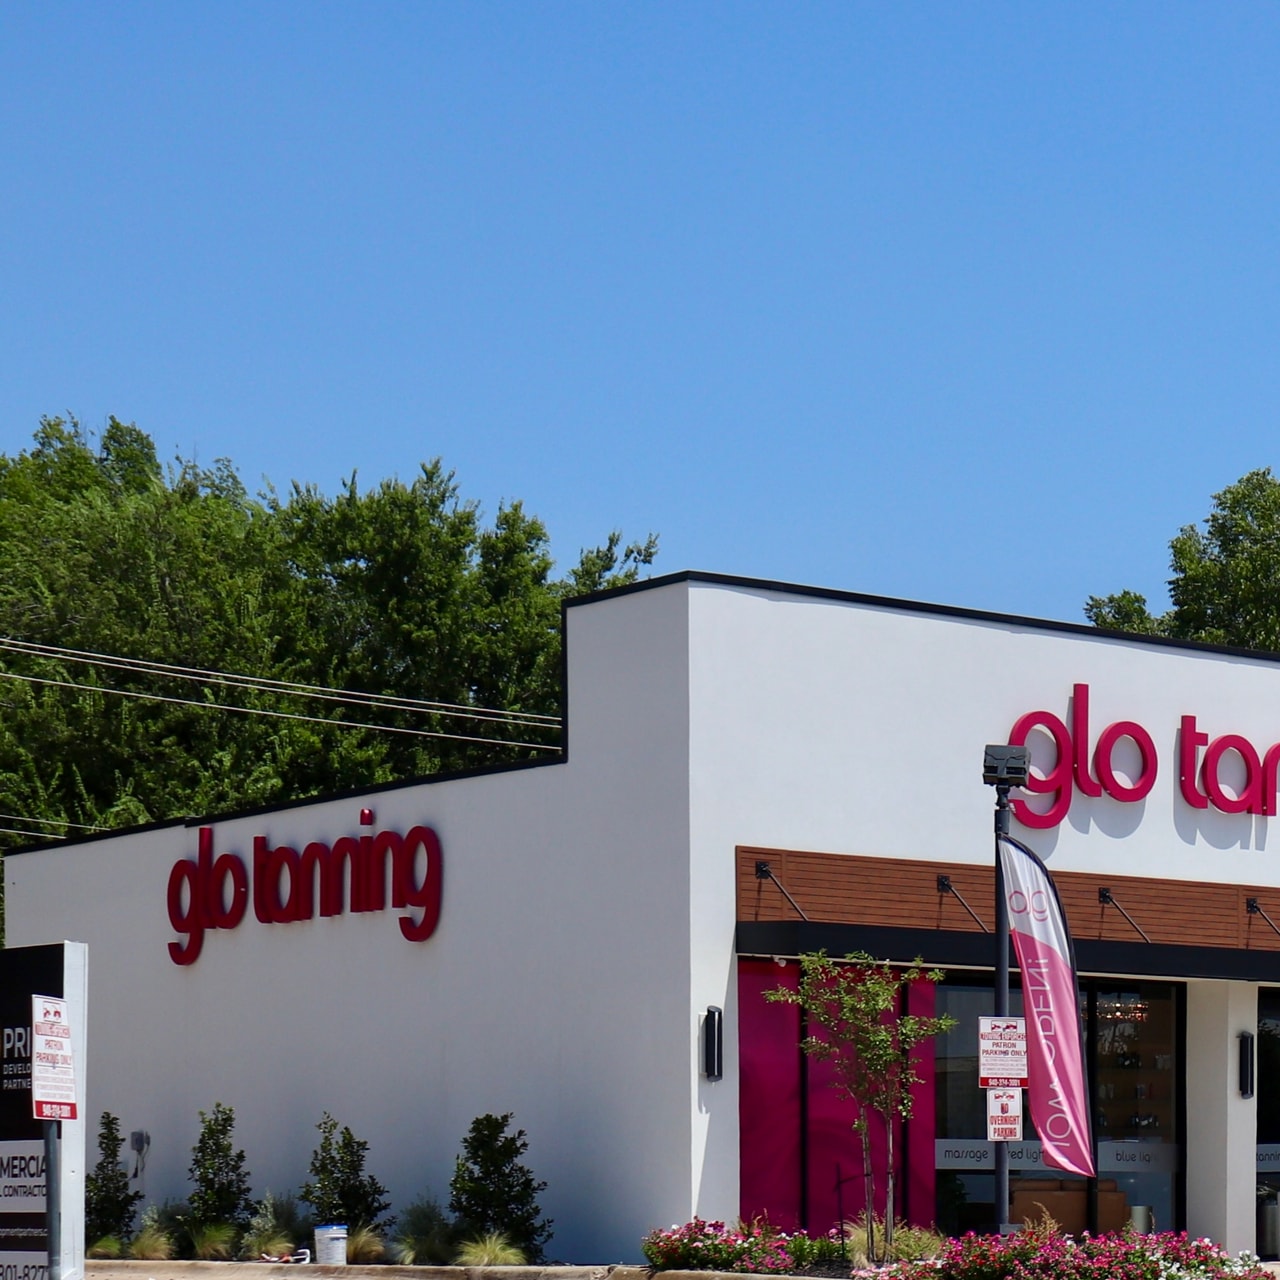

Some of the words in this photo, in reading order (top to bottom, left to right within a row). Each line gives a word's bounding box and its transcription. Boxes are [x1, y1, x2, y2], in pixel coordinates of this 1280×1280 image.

[1009, 683, 1158, 829] glo
[167, 827, 248, 966] glo
[253, 809, 443, 942] tanning
[991, 1041, 1017, 1049] PATRON
[982, 1049, 1009, 1057] PARKING
[1010, 1049, 1027, 1057] ONLY
[1000, 1102, 1010, 1115] NO
[990, 1115, 1020, 1126] OVERNIGHT
[993, 1127, 1017, 1138] PARKING
[944, 1149, 989, 1163] massage
[1116, 1151, 1138, 1162] blue
